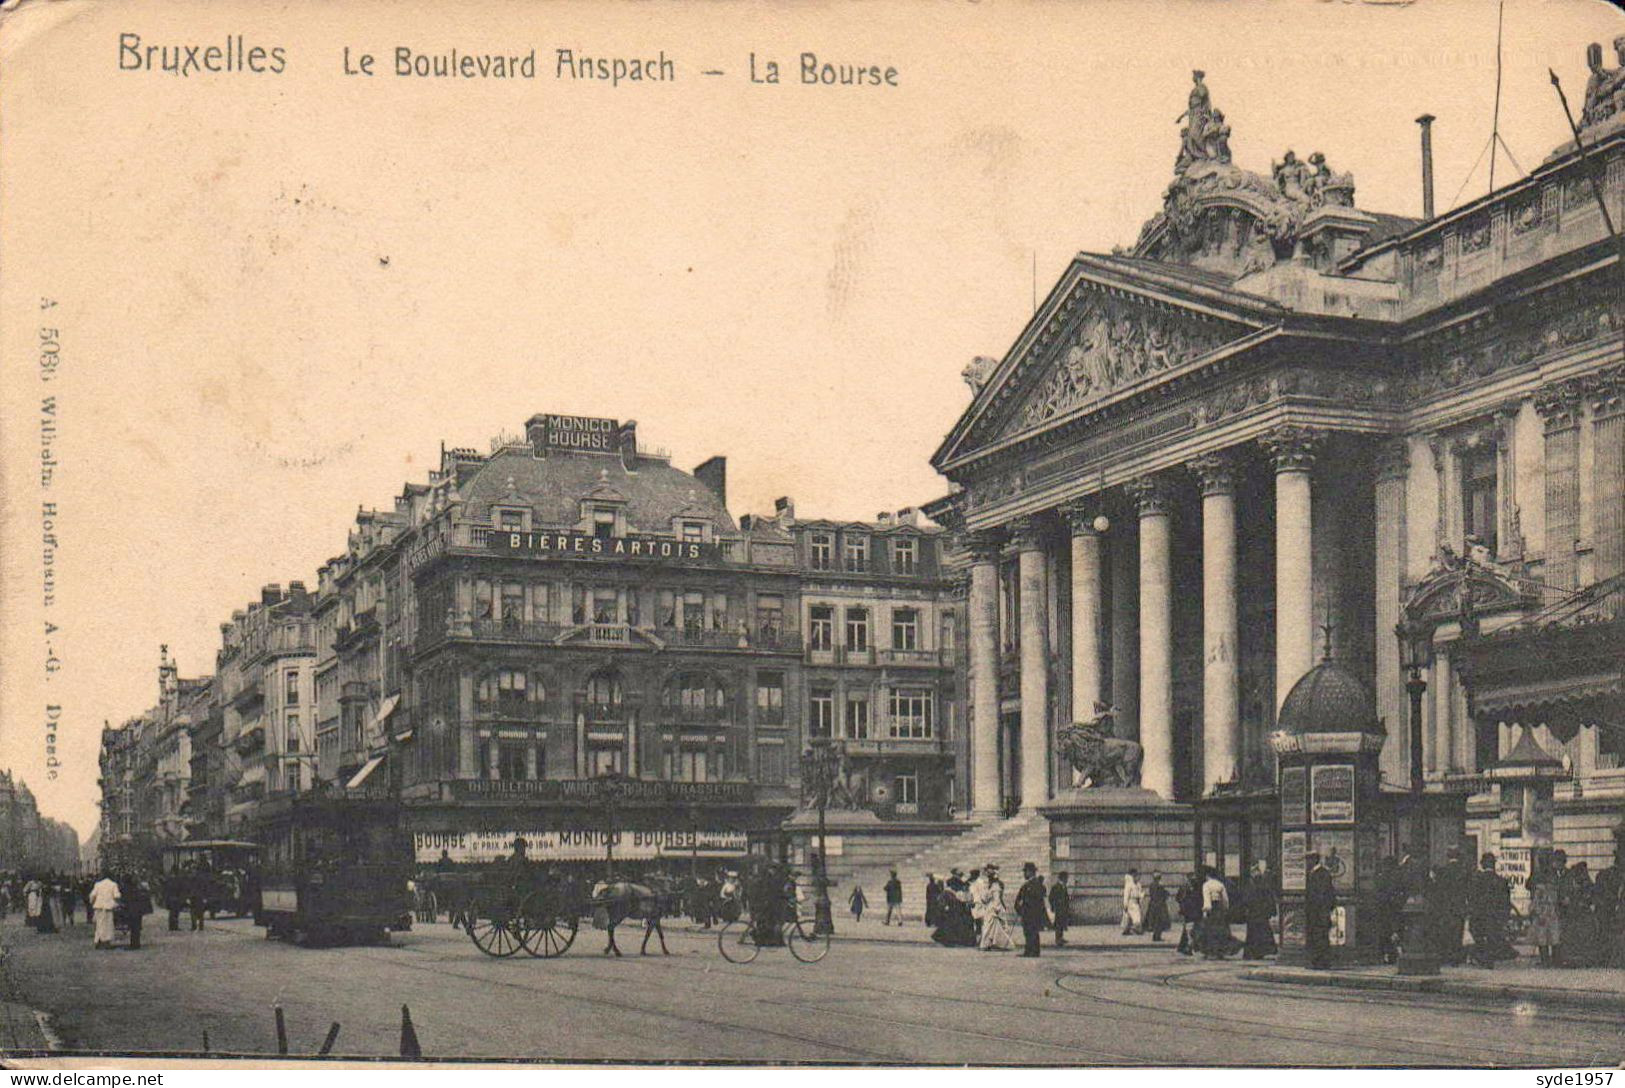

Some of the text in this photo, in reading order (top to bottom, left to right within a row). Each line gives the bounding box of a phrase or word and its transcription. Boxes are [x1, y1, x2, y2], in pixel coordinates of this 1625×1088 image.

[549, 416, 611, 431] MONICO
[549, 431, 608, 448] BOURSE
[615, 539, 700, 558] ARTOIS
[416, 832, 466, 849] BOURSE
[559, 830, 622, 847] MONICO
[633, 830, 697, 847] BOURSE
